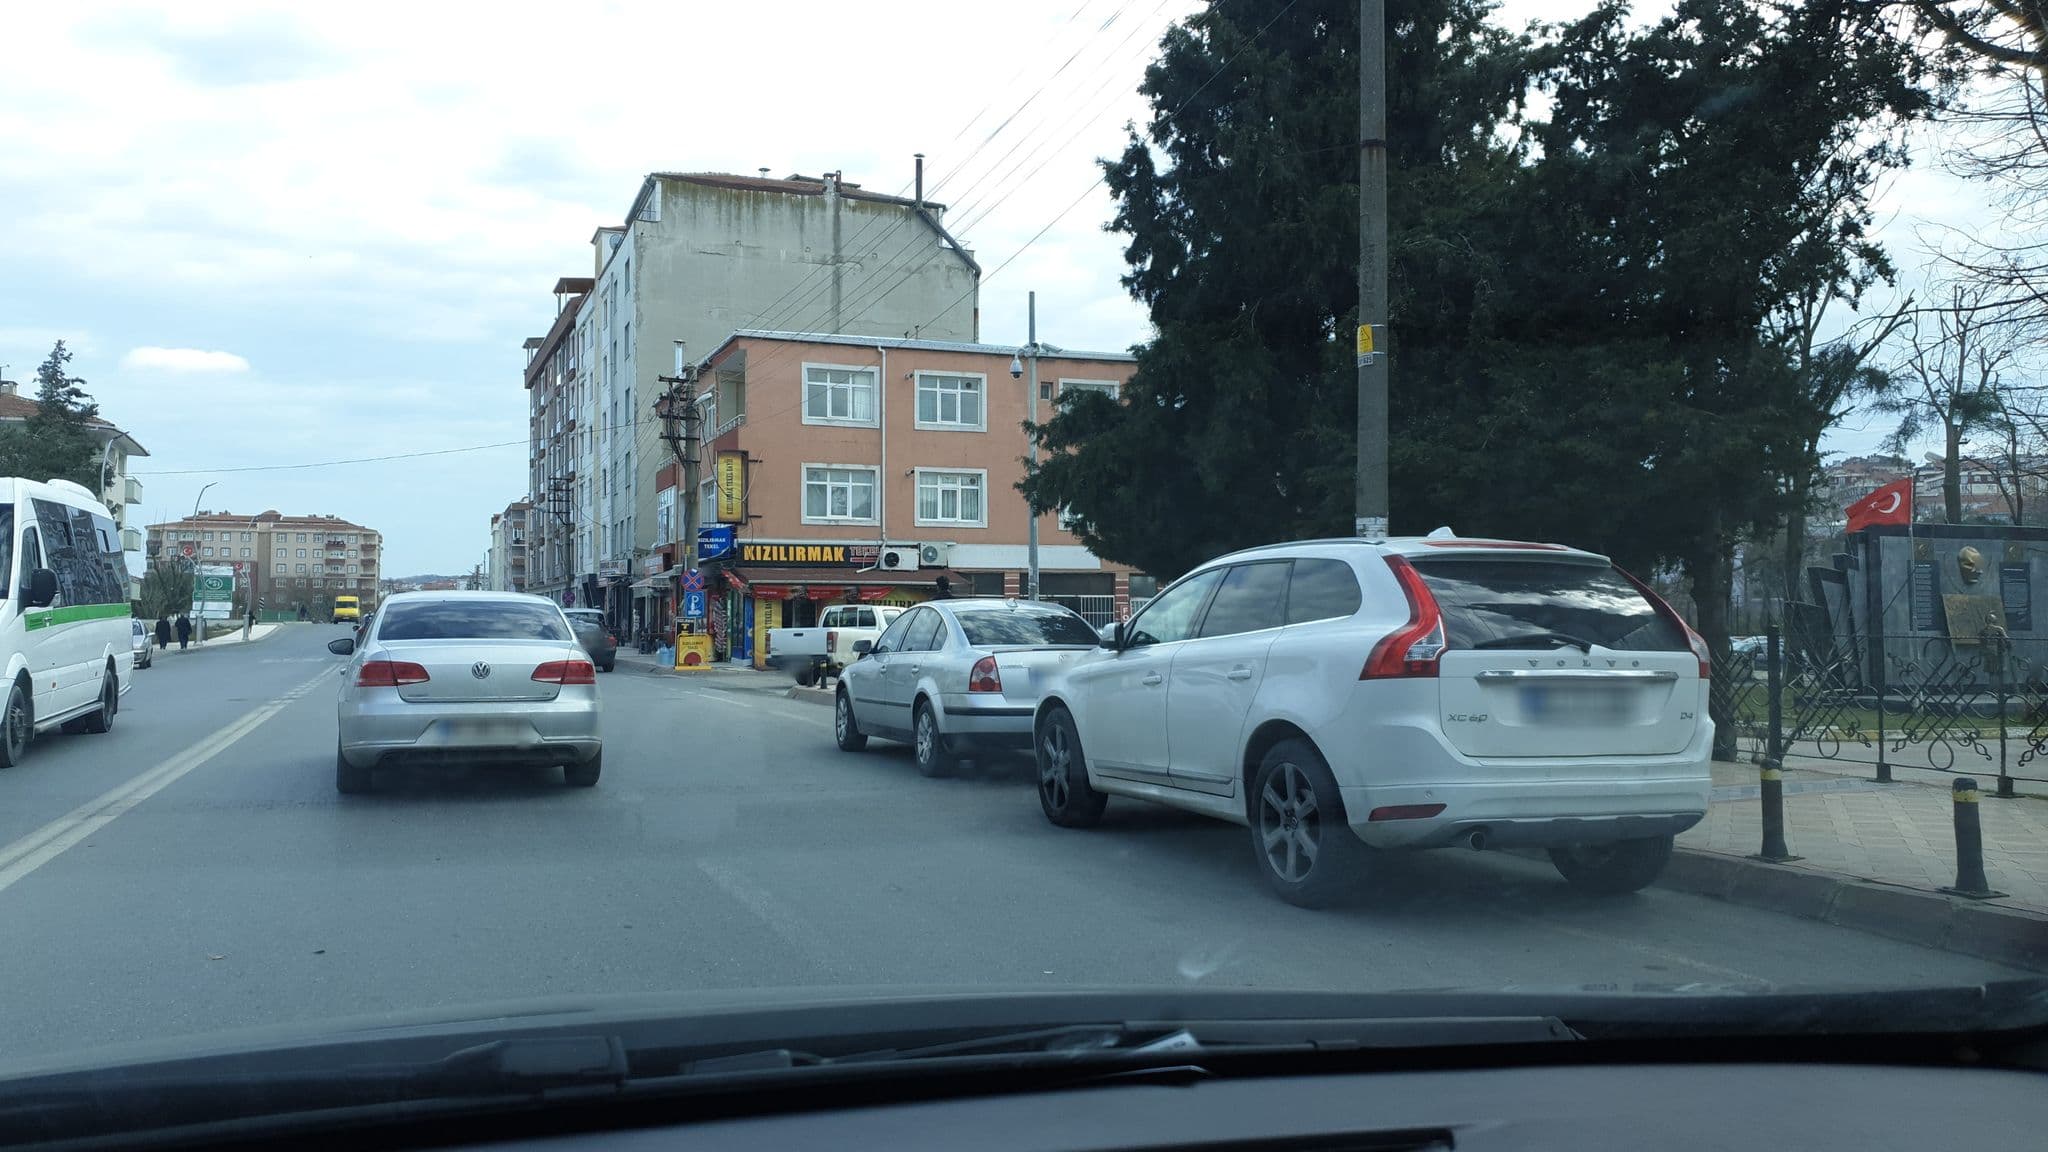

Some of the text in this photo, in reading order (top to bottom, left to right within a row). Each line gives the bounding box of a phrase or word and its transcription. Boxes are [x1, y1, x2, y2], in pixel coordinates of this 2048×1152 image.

[743, 545, 845, 561] KIZILIRMAK
[1122, 607, 1130, 621] FO
[1527, 659, 1640, 668] VOLVO
